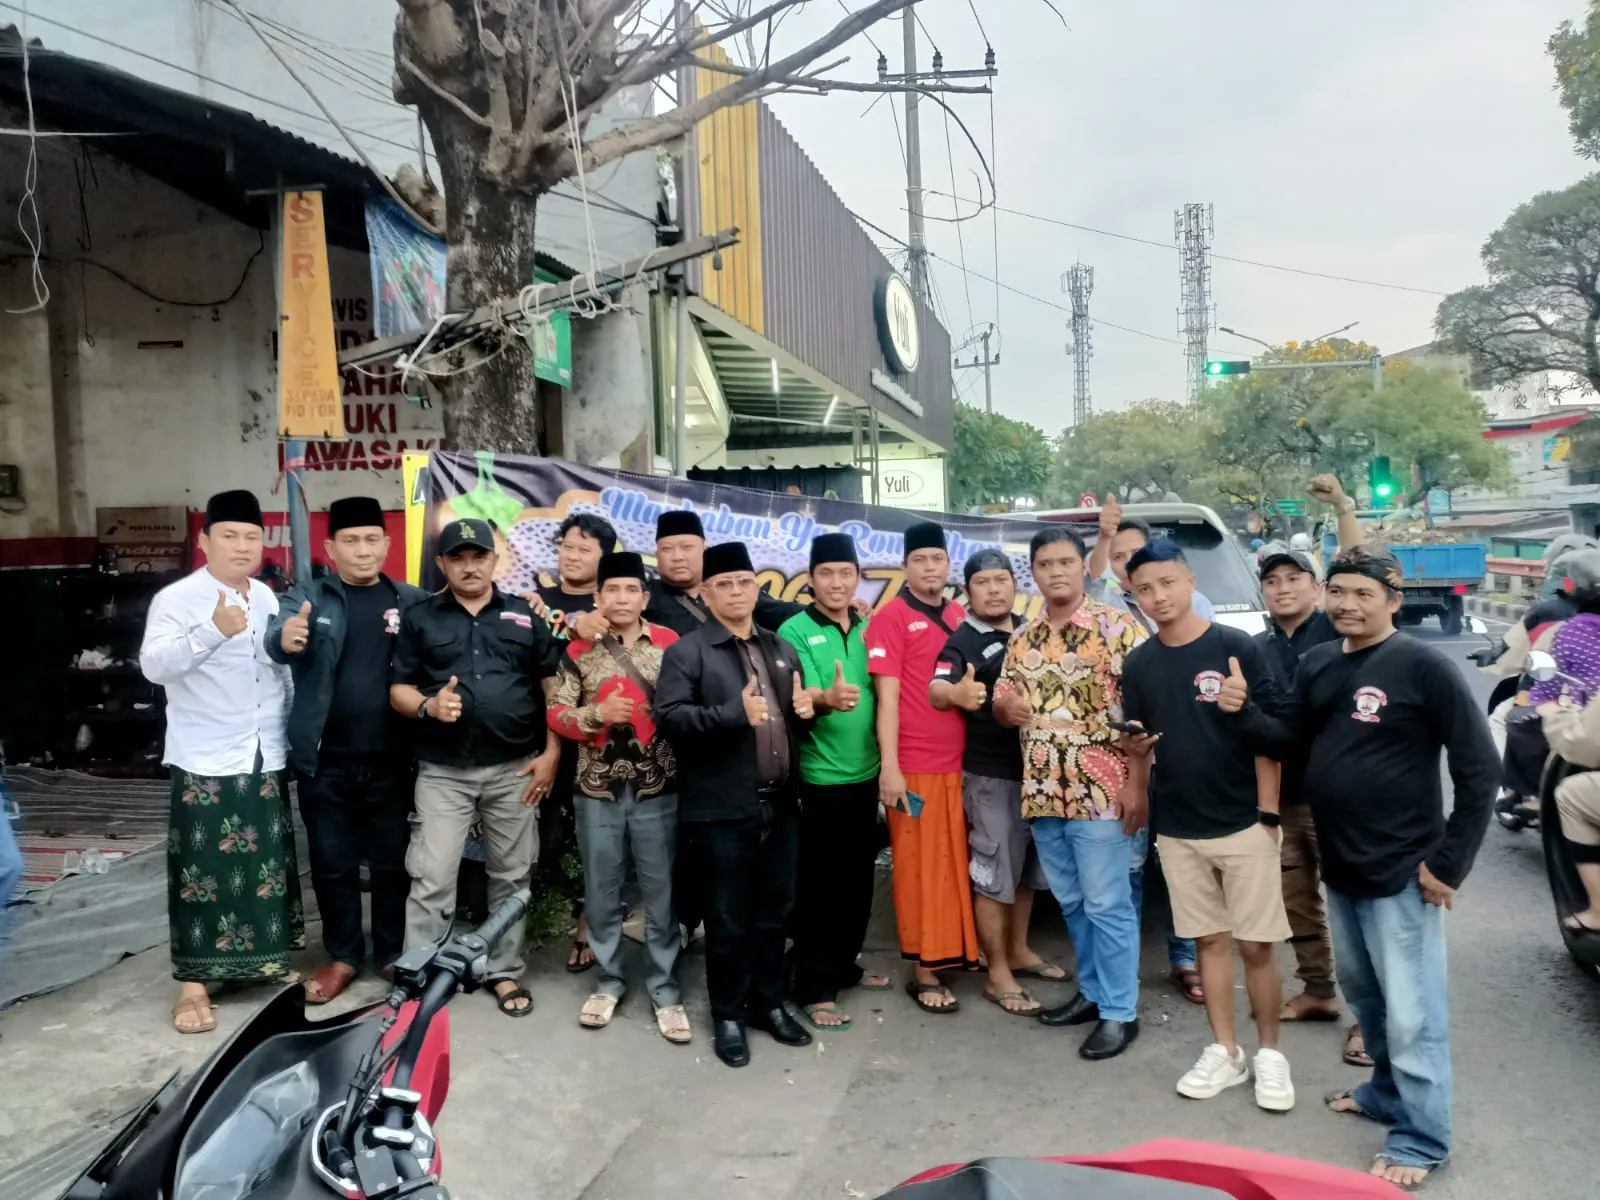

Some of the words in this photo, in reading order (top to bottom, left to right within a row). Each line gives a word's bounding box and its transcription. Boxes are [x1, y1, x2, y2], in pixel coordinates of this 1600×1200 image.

[289, 196, 320, 387] SERVICE
[884, 475, 910, 493] Yuli
[601, 487, 772, 540] Maaban
